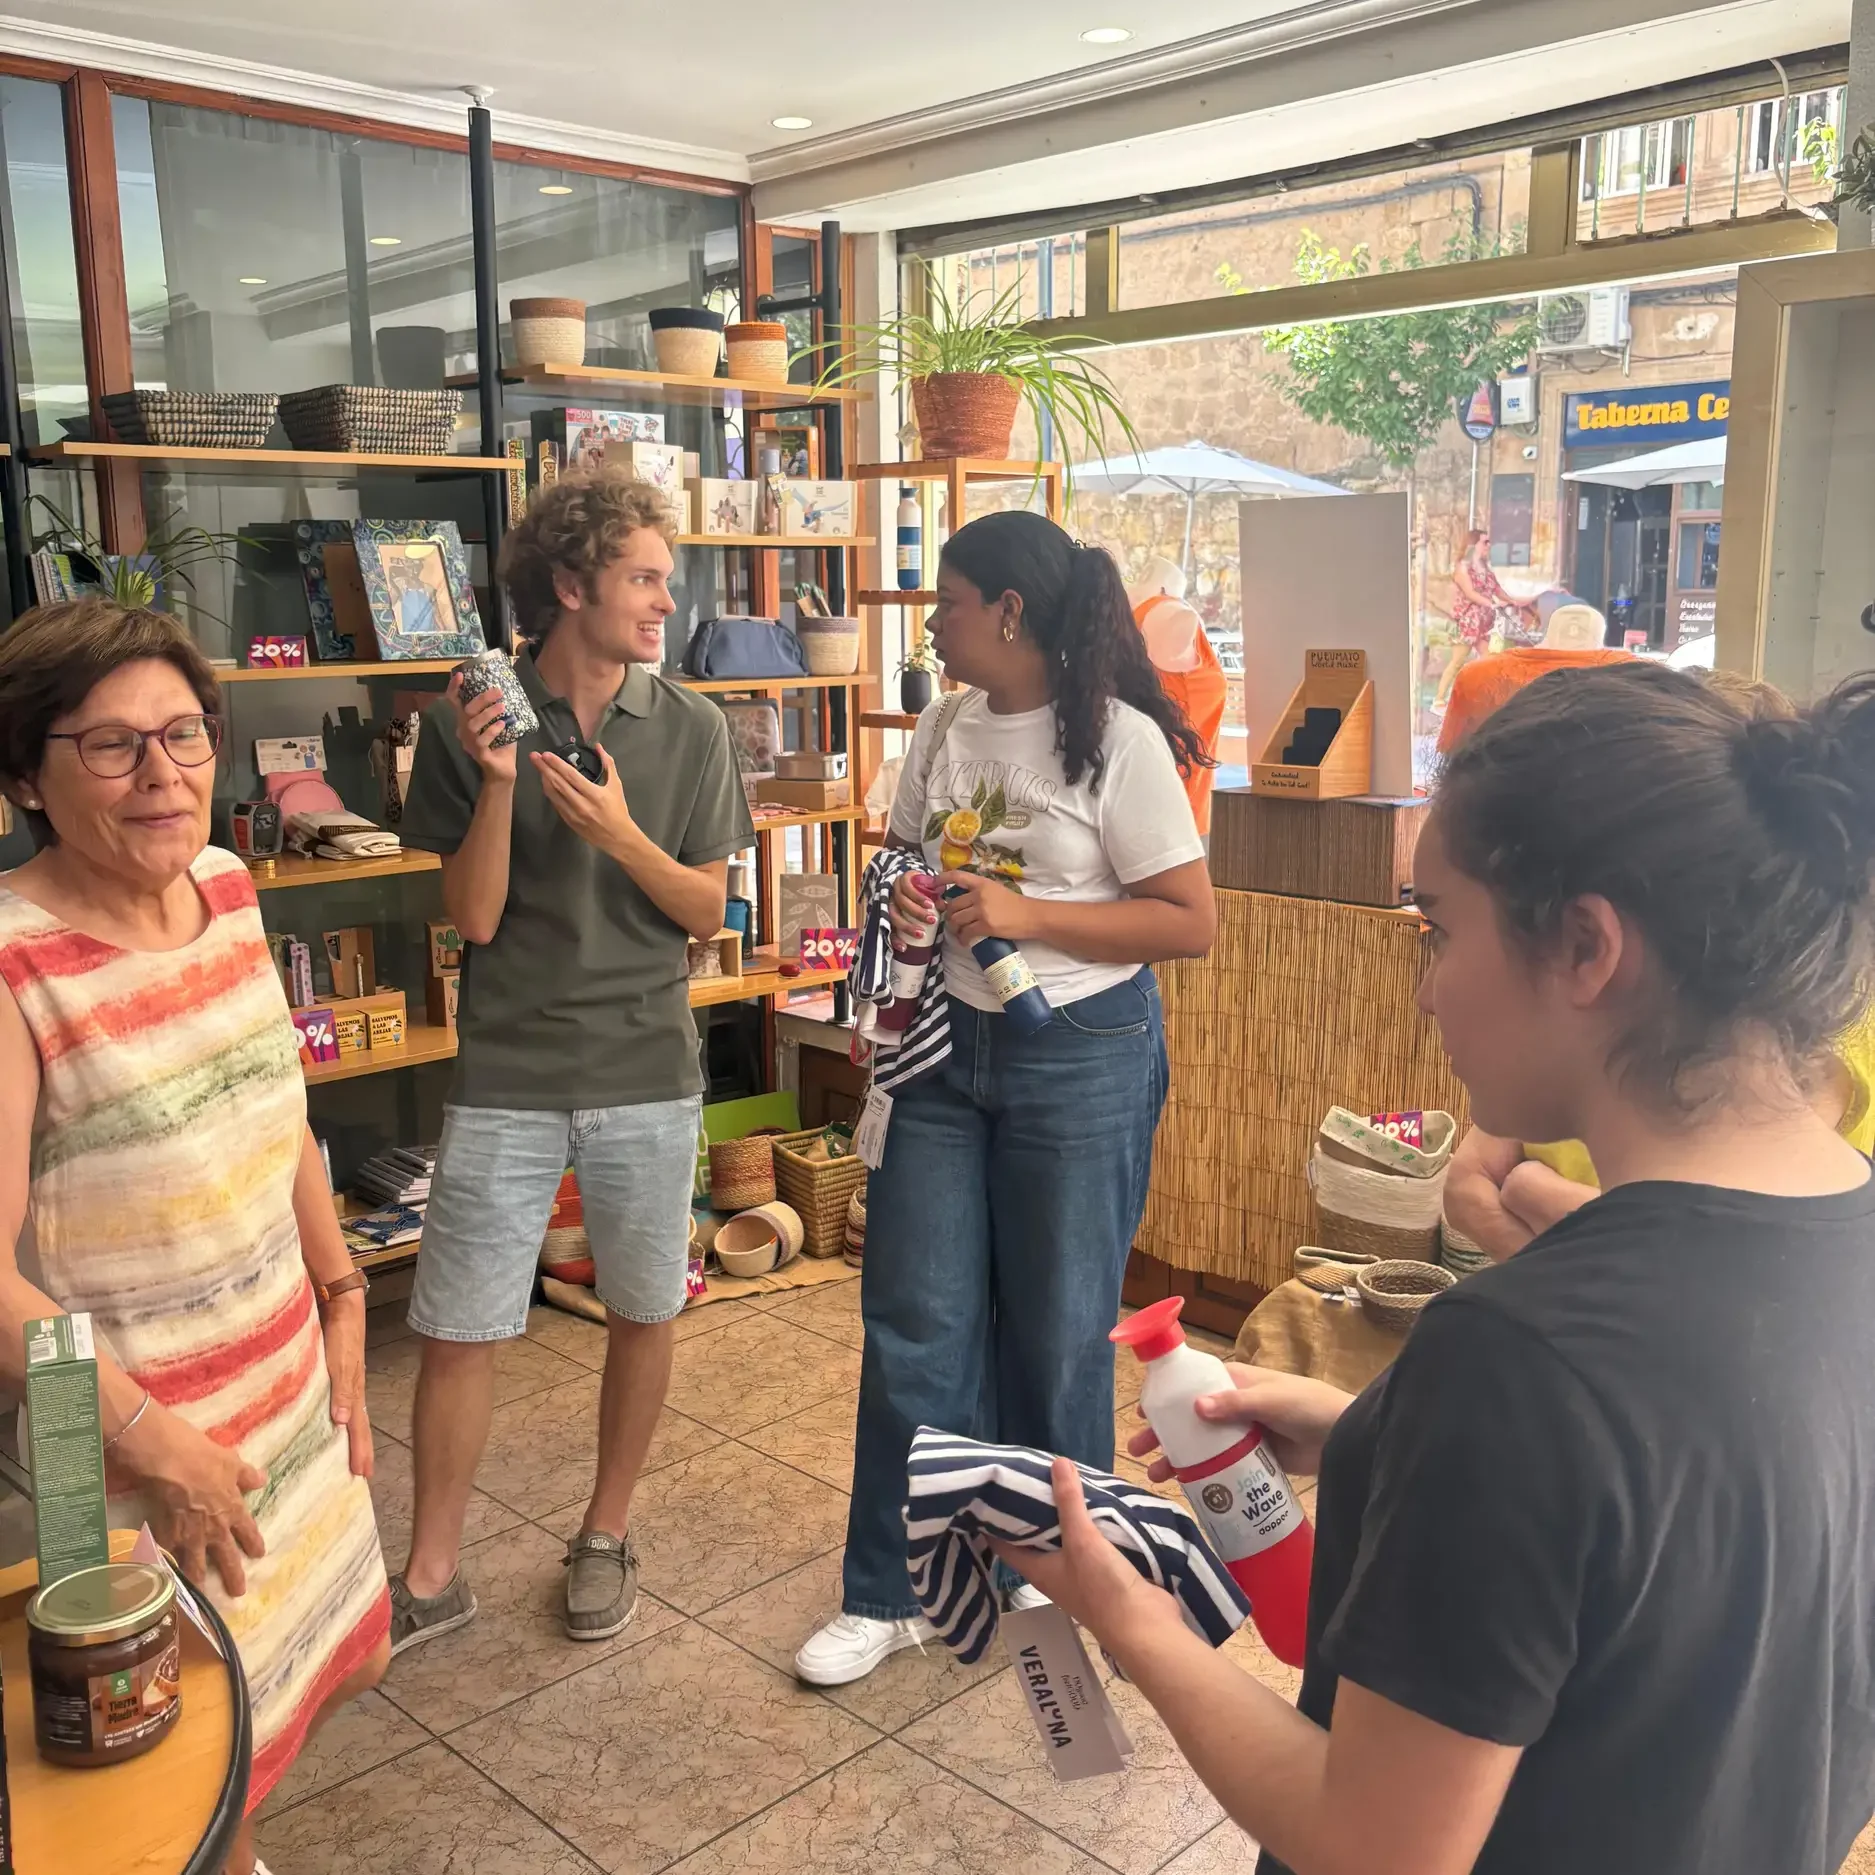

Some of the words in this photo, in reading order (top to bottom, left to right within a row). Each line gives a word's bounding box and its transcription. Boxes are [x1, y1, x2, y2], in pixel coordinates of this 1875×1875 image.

[576, 411, 591, 419] 500
[1576, 400, 1690, 430] Taberna
[1697, 392, 1730, 421] Ce
[251, 643, 301, 657] 20%
[1311, 652, 1360, 661] PUTUMAYO
[927, 760, 1058, 812] CITRUS
[803, 938, 856, 957] 20%
[336, 1019, 360, 1027] ALVEMOS
[371, 1014, 398, 1023] SALVEMOS
[292, 1023, 334, 1049] 0%
[1236, 1467, 1266, 1494] Join
[1246, 1482, 1271, 1503] the
[1241, 1489, 1284, 1521] Wave
